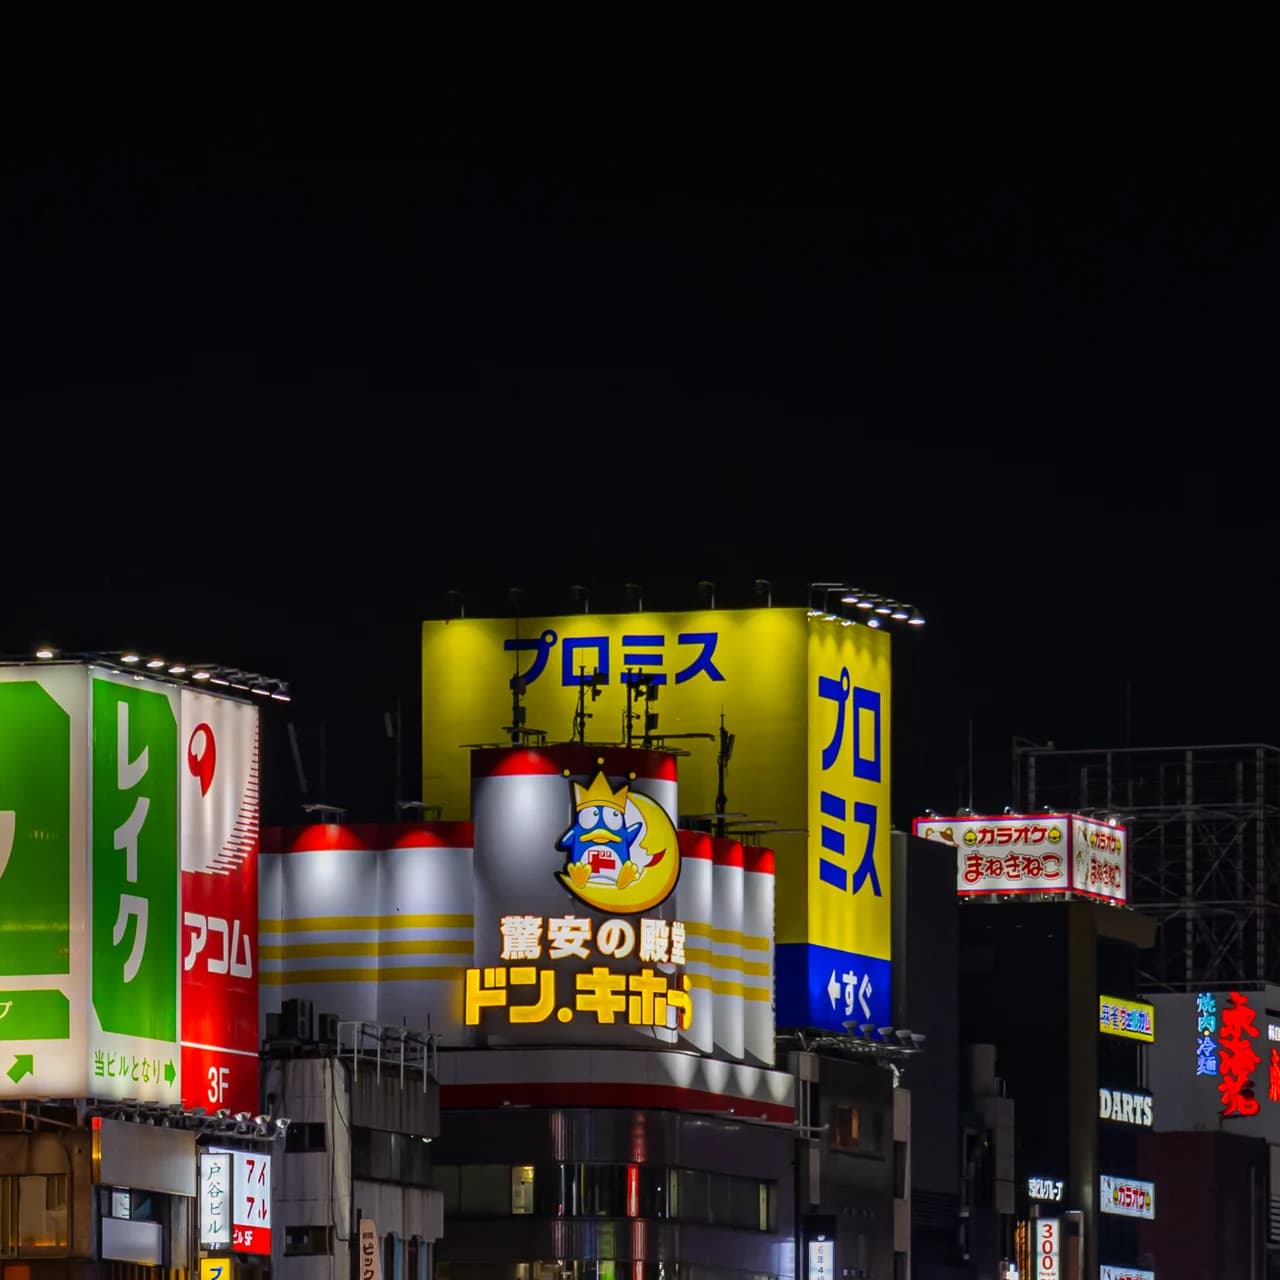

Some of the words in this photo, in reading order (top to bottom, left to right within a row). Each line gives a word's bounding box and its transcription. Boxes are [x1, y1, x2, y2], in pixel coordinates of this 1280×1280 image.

[503, 629, 727, 687] プロミス
[112, 700, 150, 984] レイク
[976, 825, 1048, 846] カラオケ
[962, 850, 1062, 884] まねきねこ
[183, 911, 253, 979] アコム
[500, 915, 687, 966] 驚安の殿堂
[841, 968, 873, 1020] すぐ
[207, 1066, 230, 1103] 3F
[1099, 1087, 1153, 1137] DARTS
[208, 1162, 224, 1235] 戸谷ビル
[1042, 1224, 1053, 1270] 300
